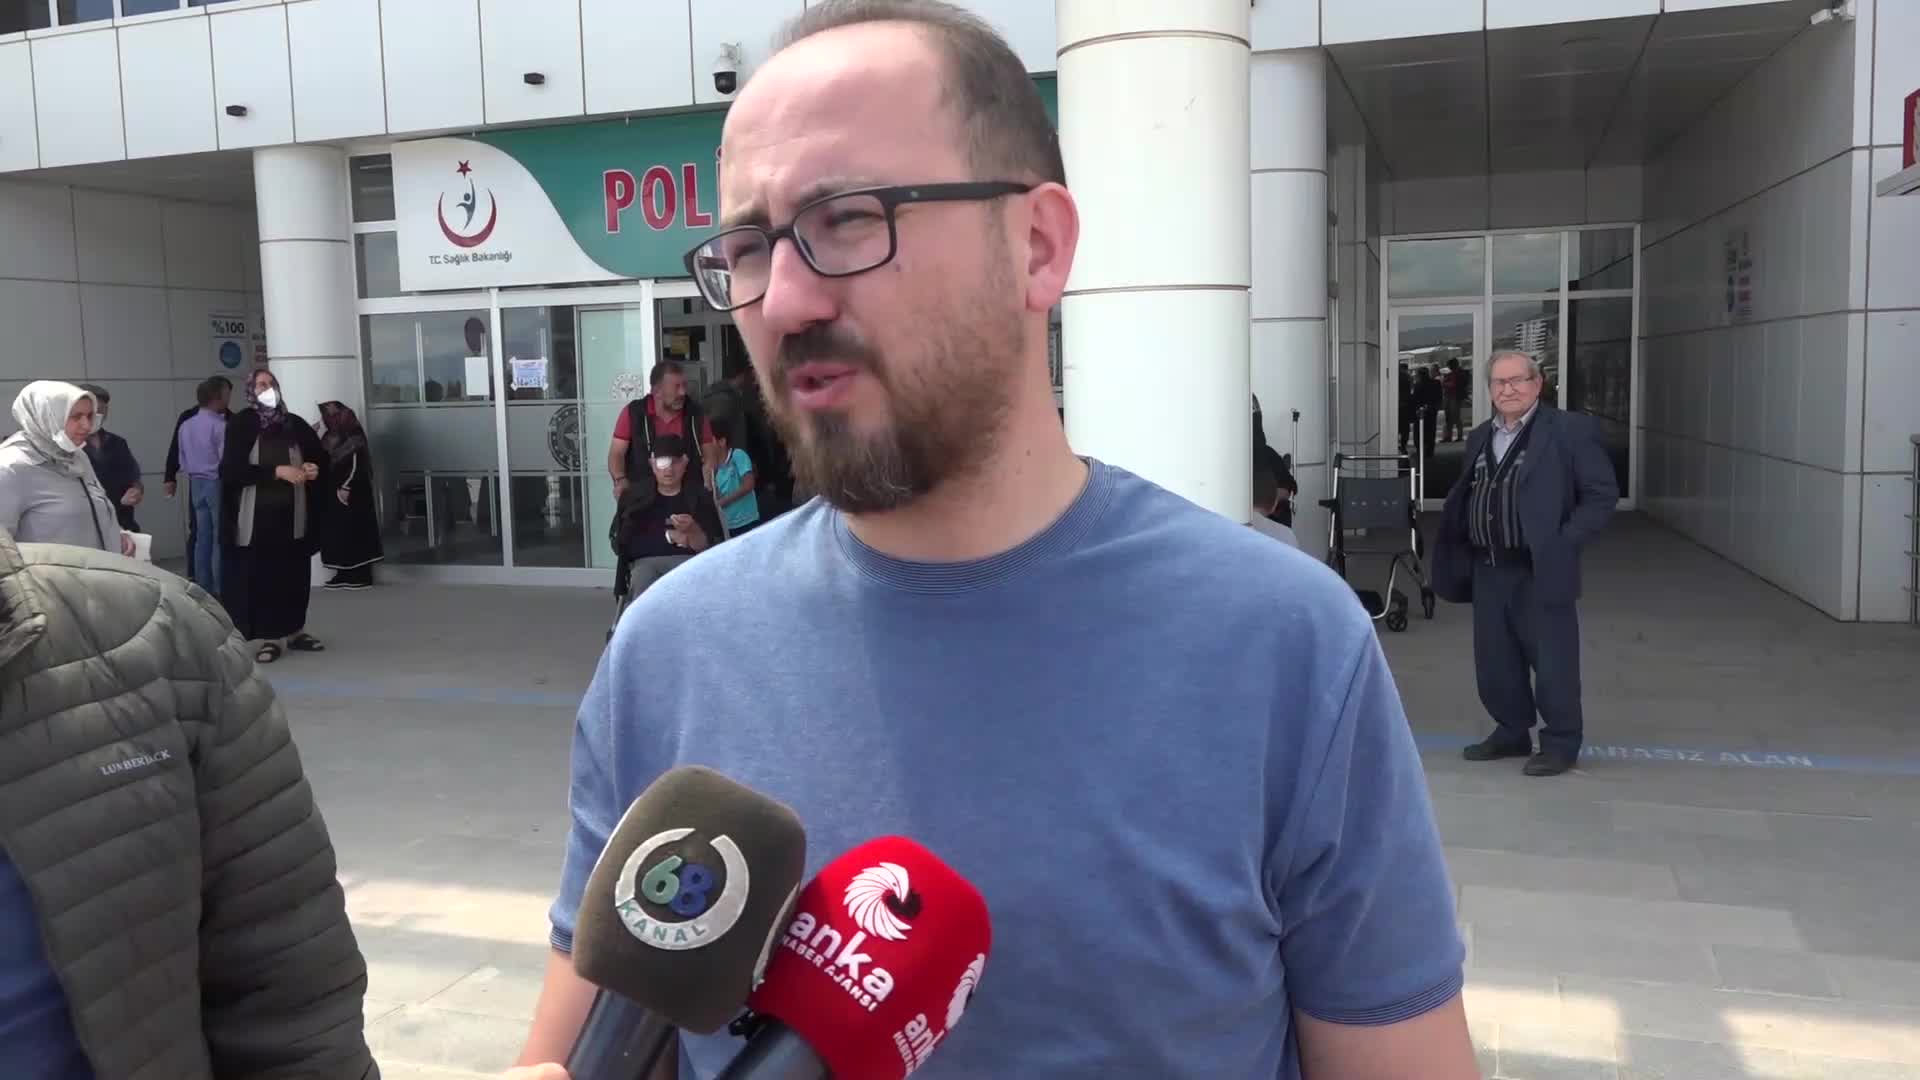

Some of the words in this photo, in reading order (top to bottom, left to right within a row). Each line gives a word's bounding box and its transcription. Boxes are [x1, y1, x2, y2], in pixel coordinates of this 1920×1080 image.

[602, 145, 722, 234] POL
[618, 900, 707, 943] KANAL
[641, 855, 714, 918] 68
[789, 911, 895, 1003] anka
